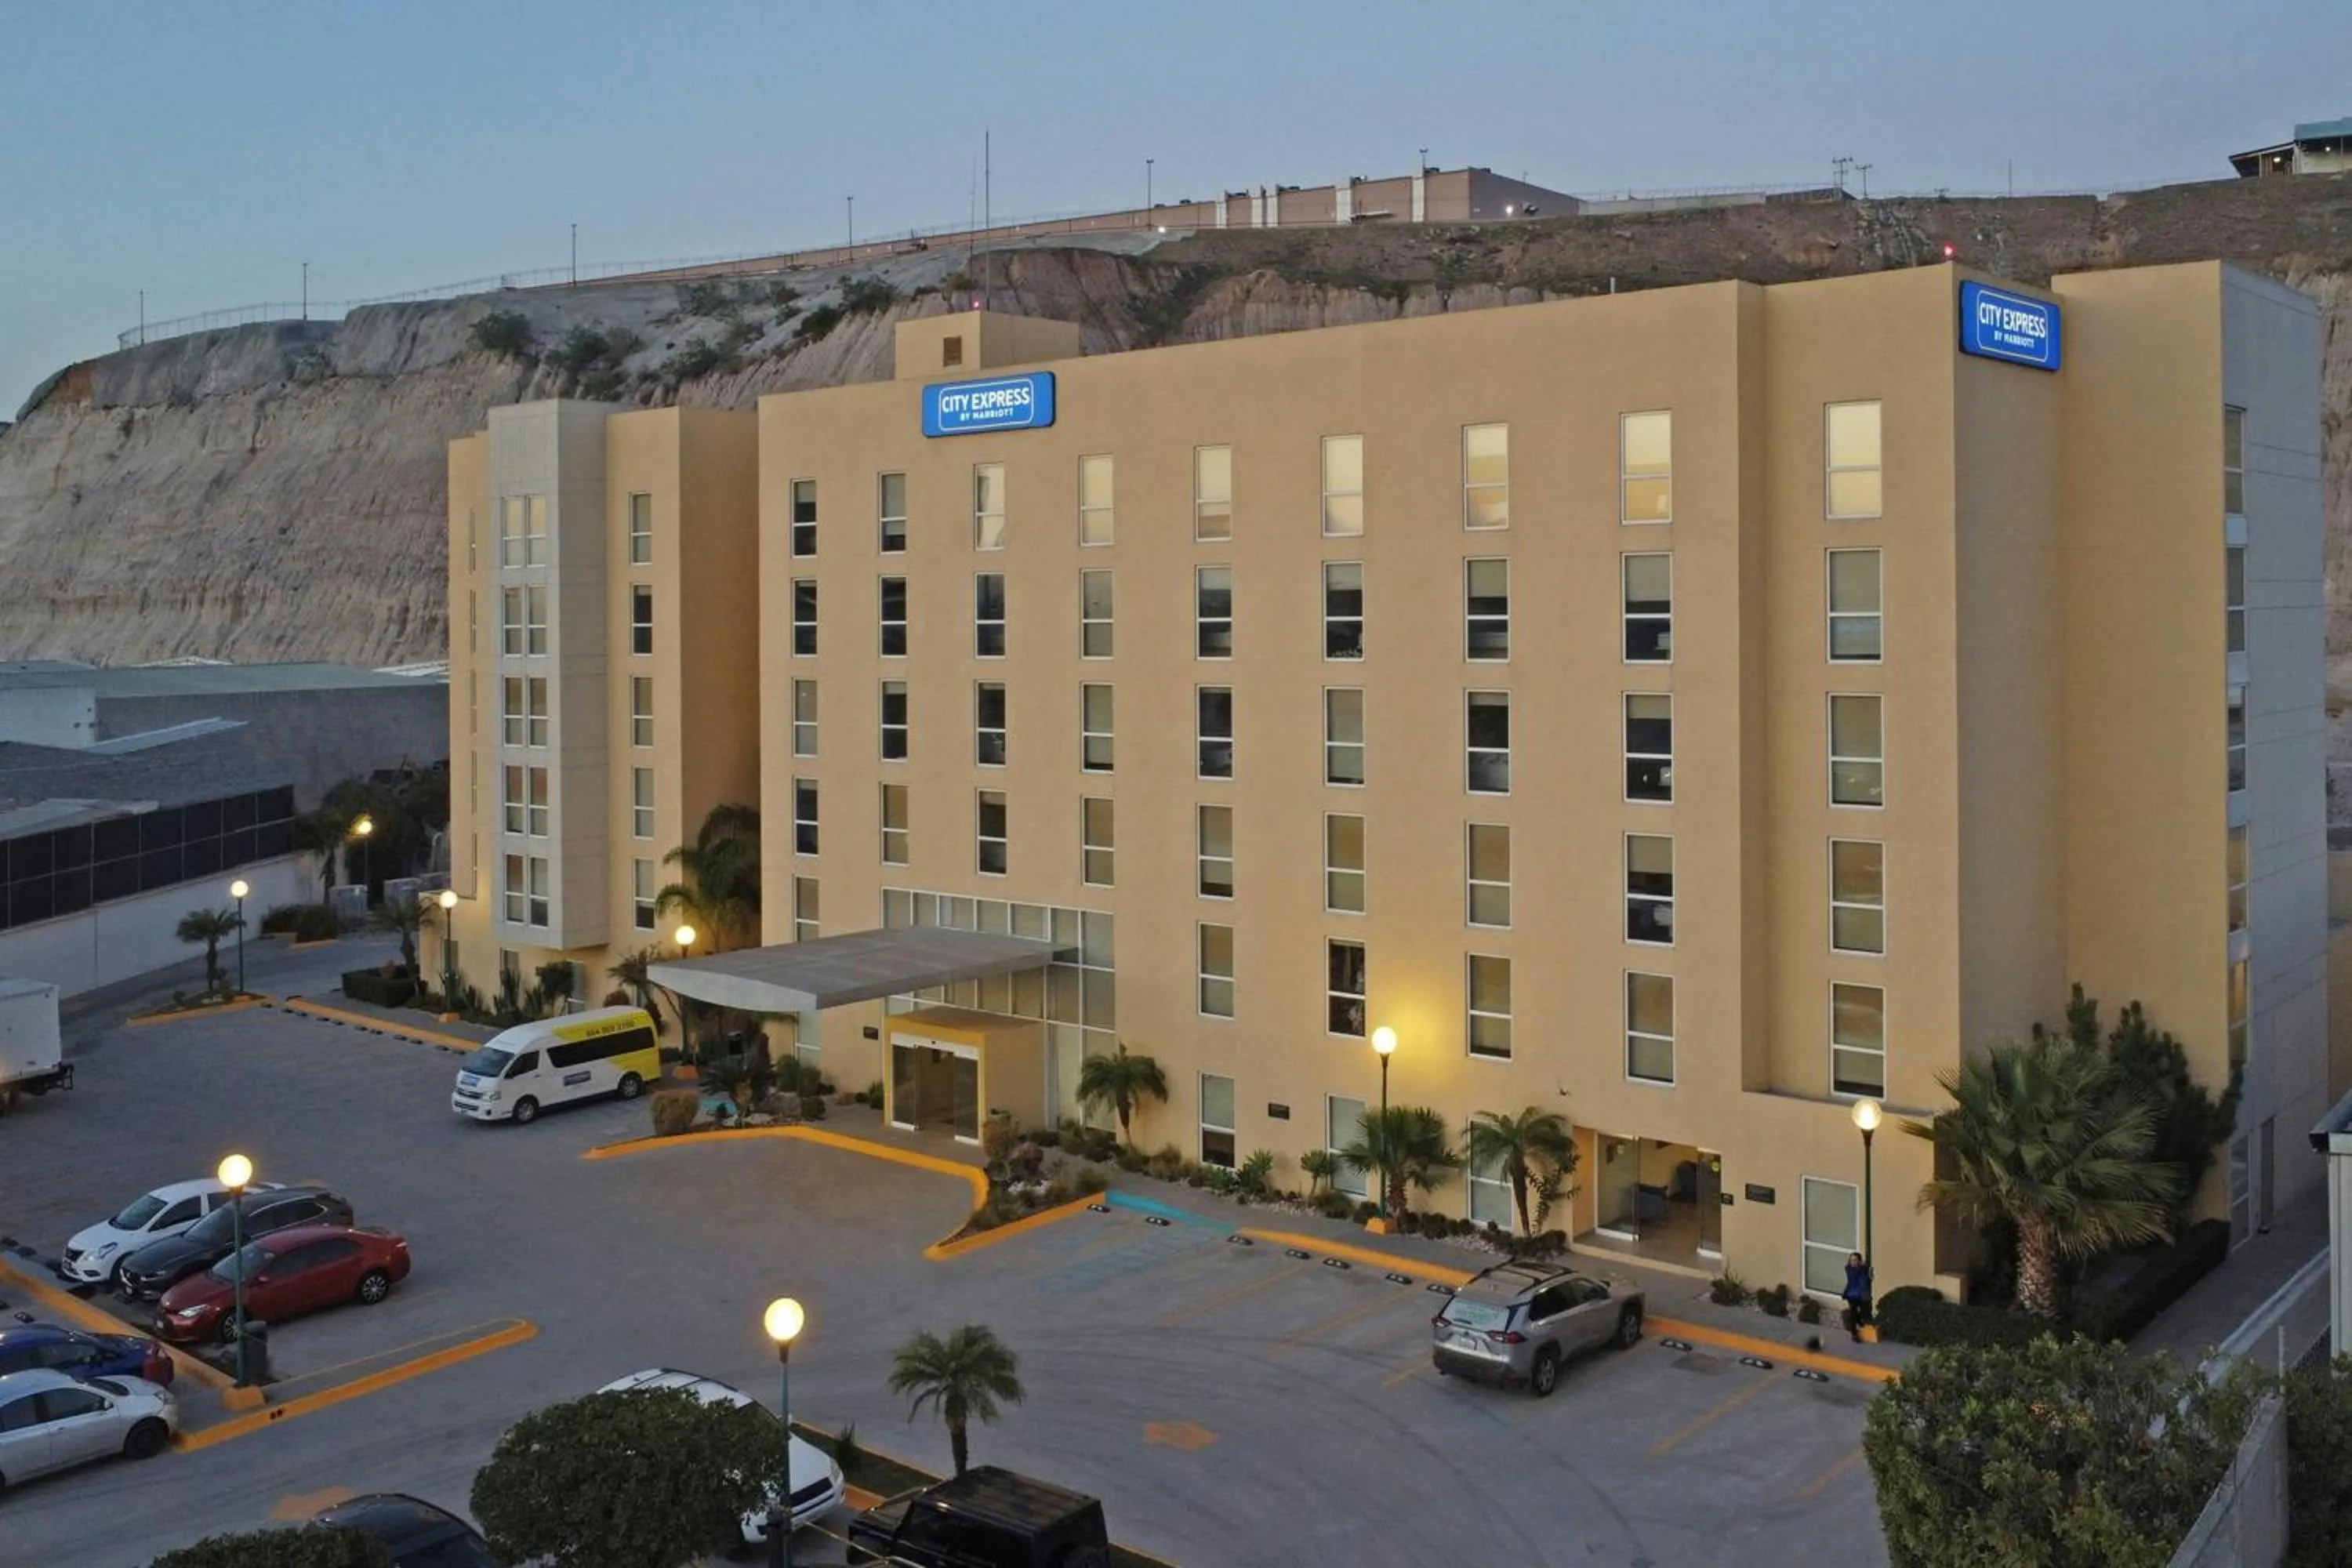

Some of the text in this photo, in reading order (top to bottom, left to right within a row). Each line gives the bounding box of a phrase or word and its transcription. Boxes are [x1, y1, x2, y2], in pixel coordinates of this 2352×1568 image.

[1980, 303, 2045, 338] CITY EXPRESS
[1994, 331, 2002, 340] BY
[942, 387, 1029, 412] CITY EXPRESS
[973, 408, 1014, 419] MARRIOTT
